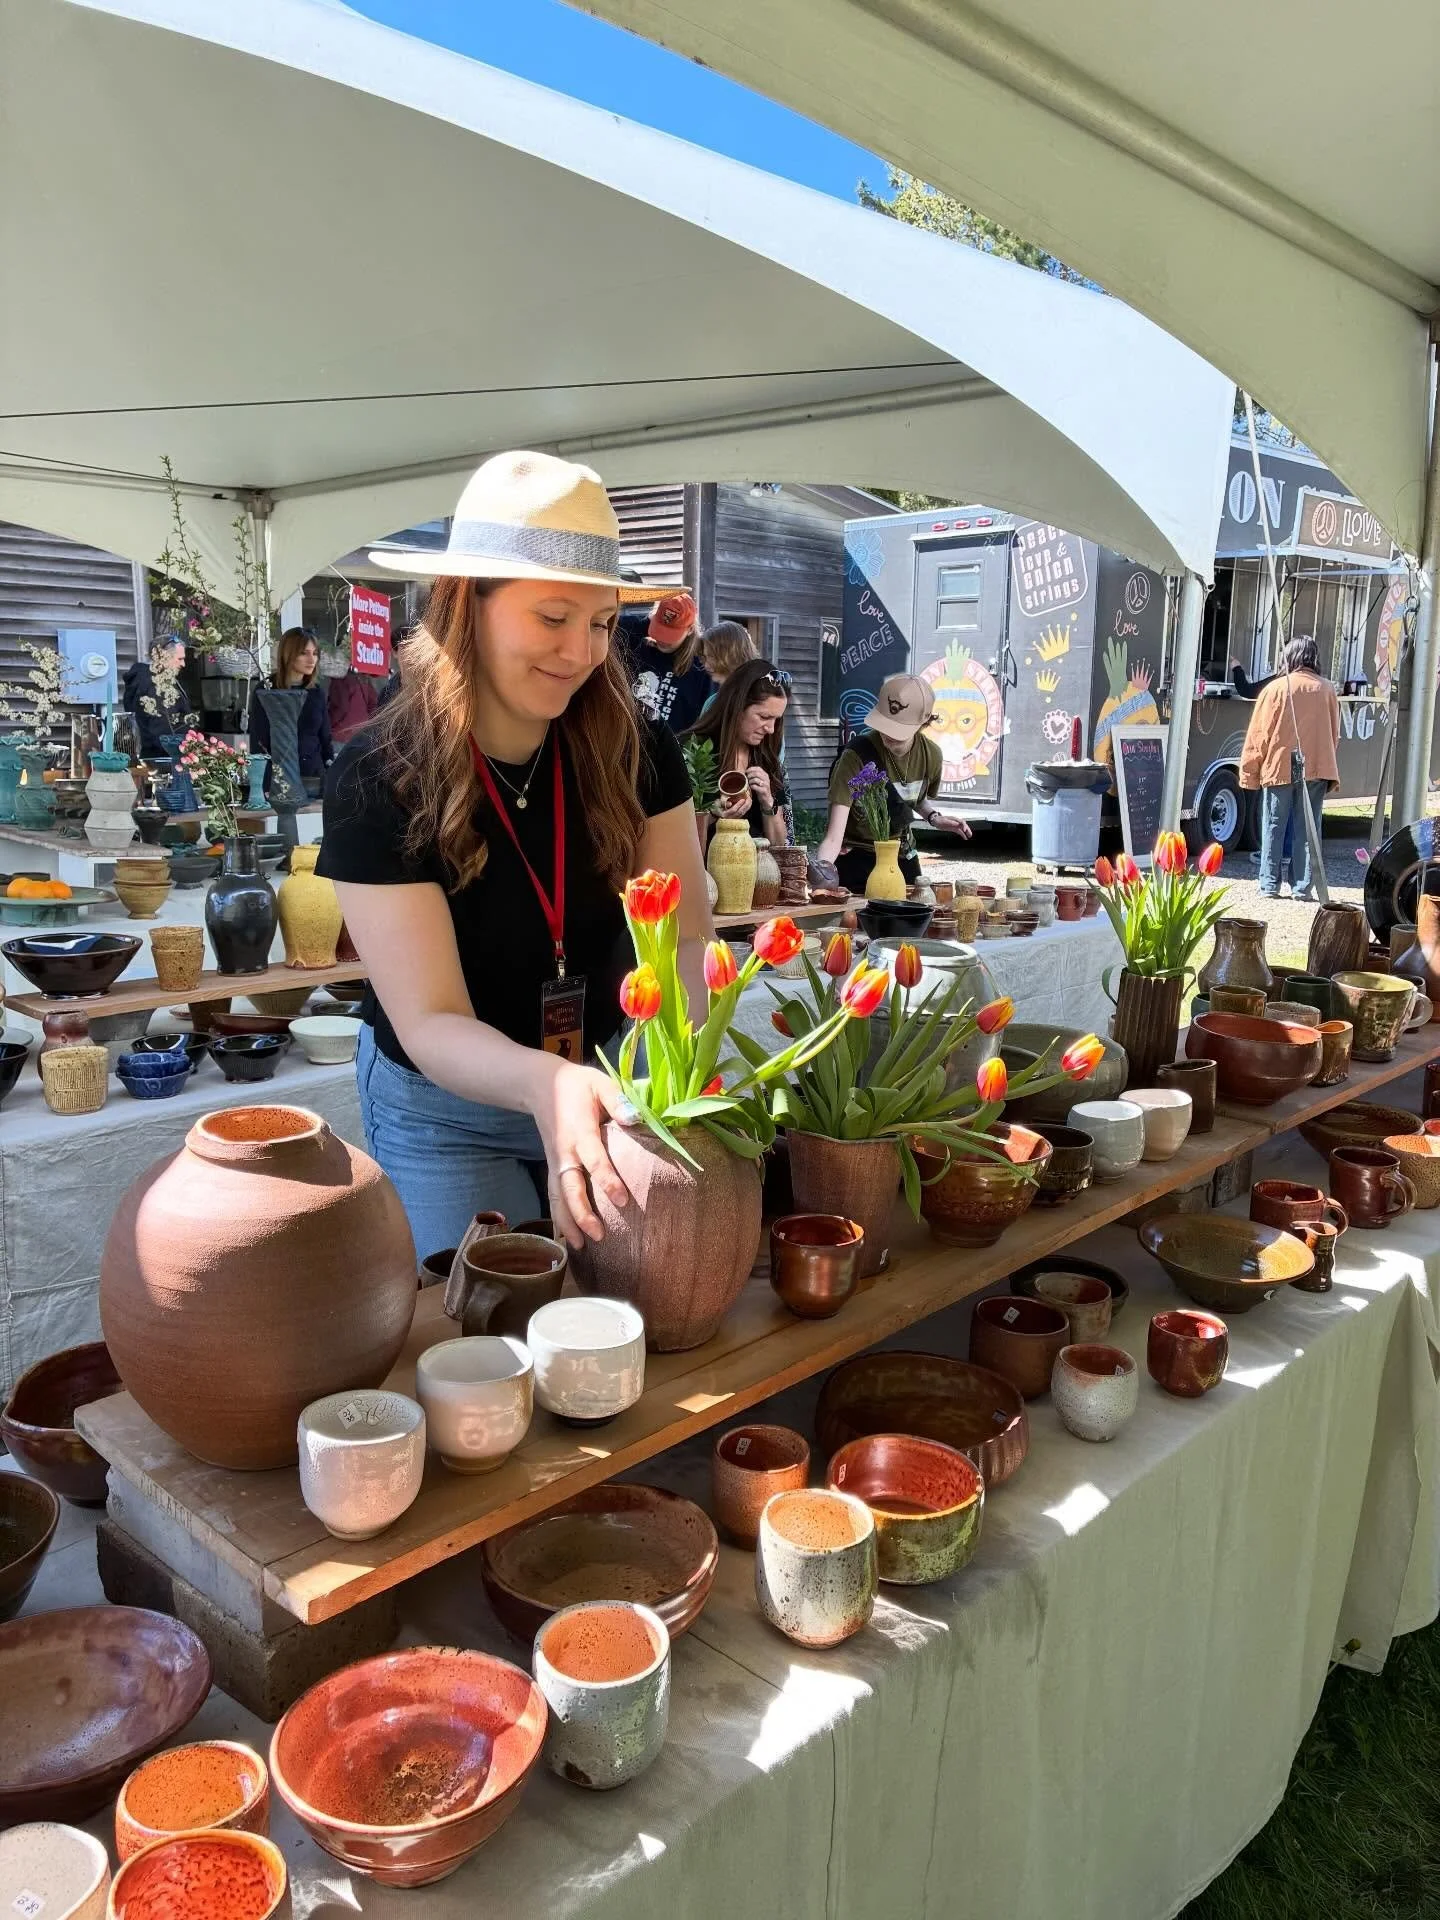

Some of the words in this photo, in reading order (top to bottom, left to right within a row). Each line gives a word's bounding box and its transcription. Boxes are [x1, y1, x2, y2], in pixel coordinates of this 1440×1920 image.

[1221, 470, 1286, 529] ON
[1341, 508, 1382, 546] LOVE
[1056, 542, 1068, 558] &
[352, 593, 369, 613] More
[368, 597, 390, 623] Pottery
[857, 590, 886, 624] love
[1024, 578, 1080, 610] strings
[358, 618, 375, 636] inside
[374, 622, 385, 638] the
[1114, 608, 1140, 637] love
[356, 640, 384, 667] Studio
[840, 623, 895, 675] PEACE
